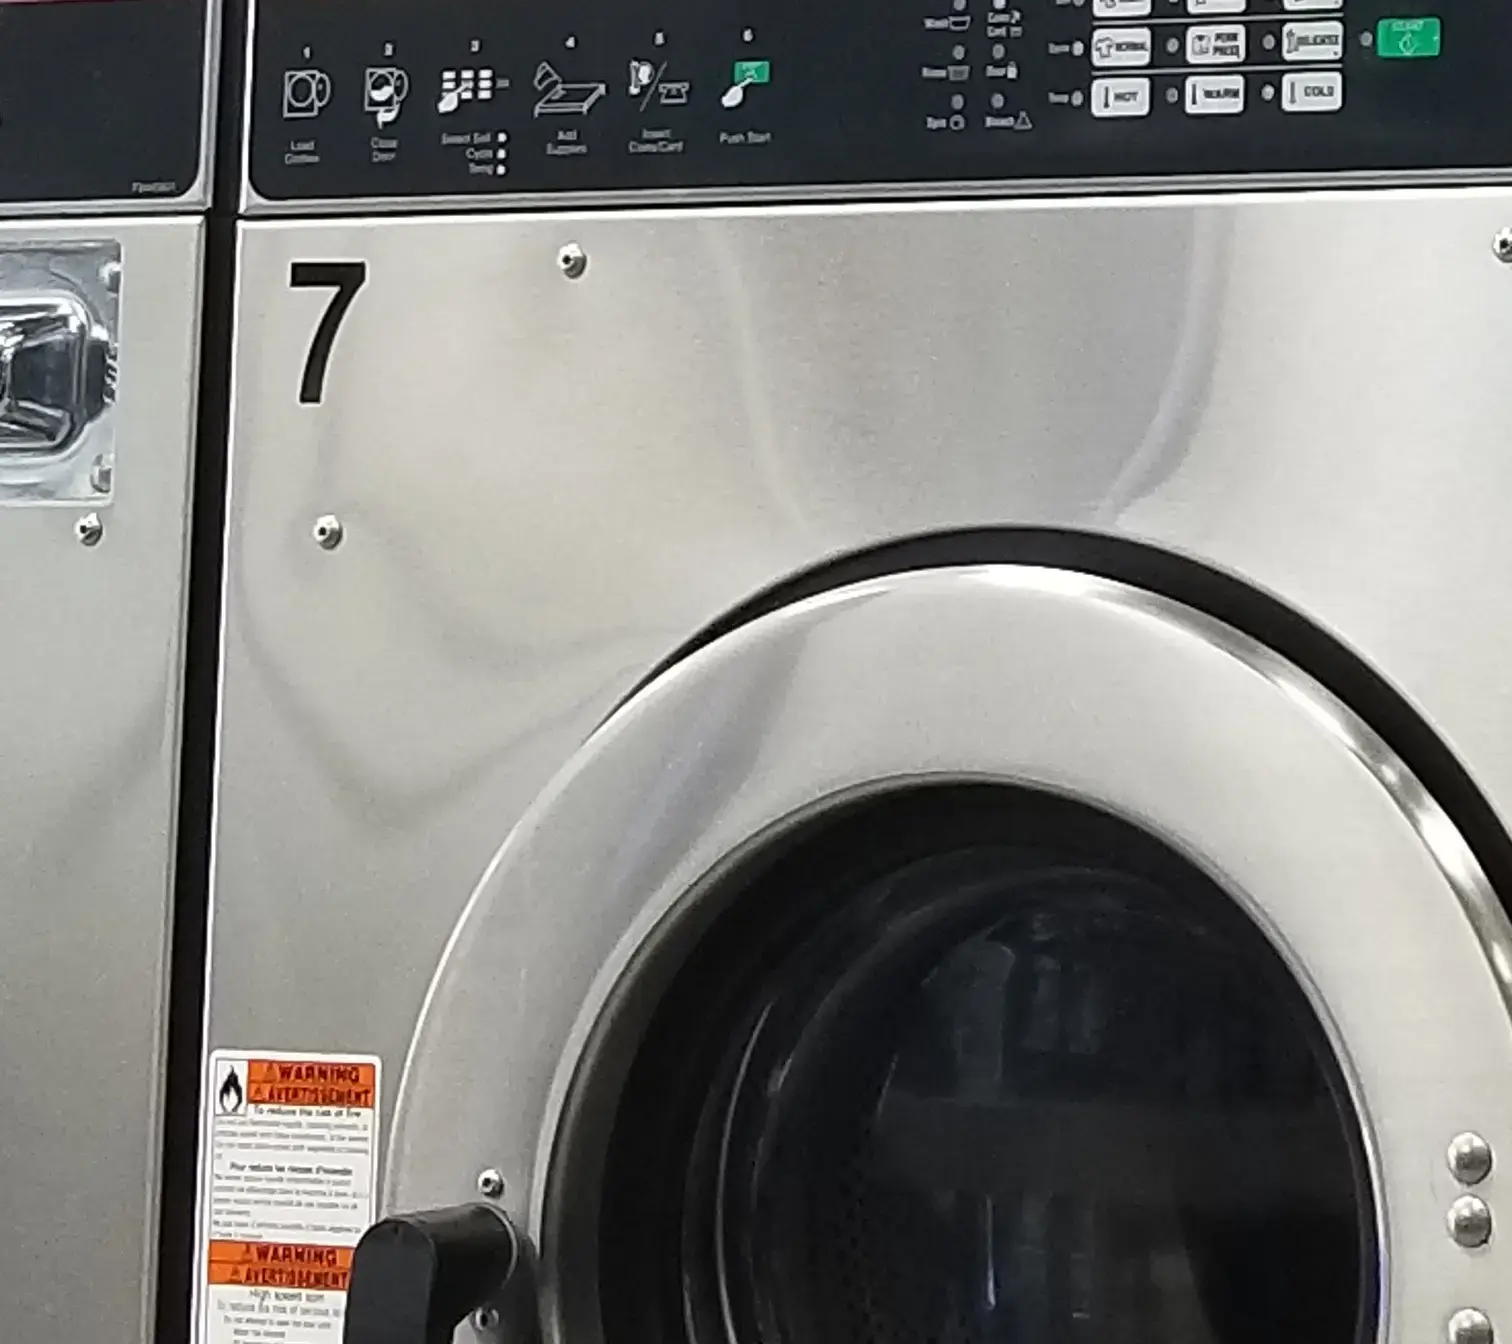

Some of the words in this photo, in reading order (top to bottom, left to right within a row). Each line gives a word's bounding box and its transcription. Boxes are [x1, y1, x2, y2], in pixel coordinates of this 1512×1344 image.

[290, 262, 367, 404] 7
[278, 1065, 361, 1084] WARNING
[255, 1245, 338, 1267] WARNING
